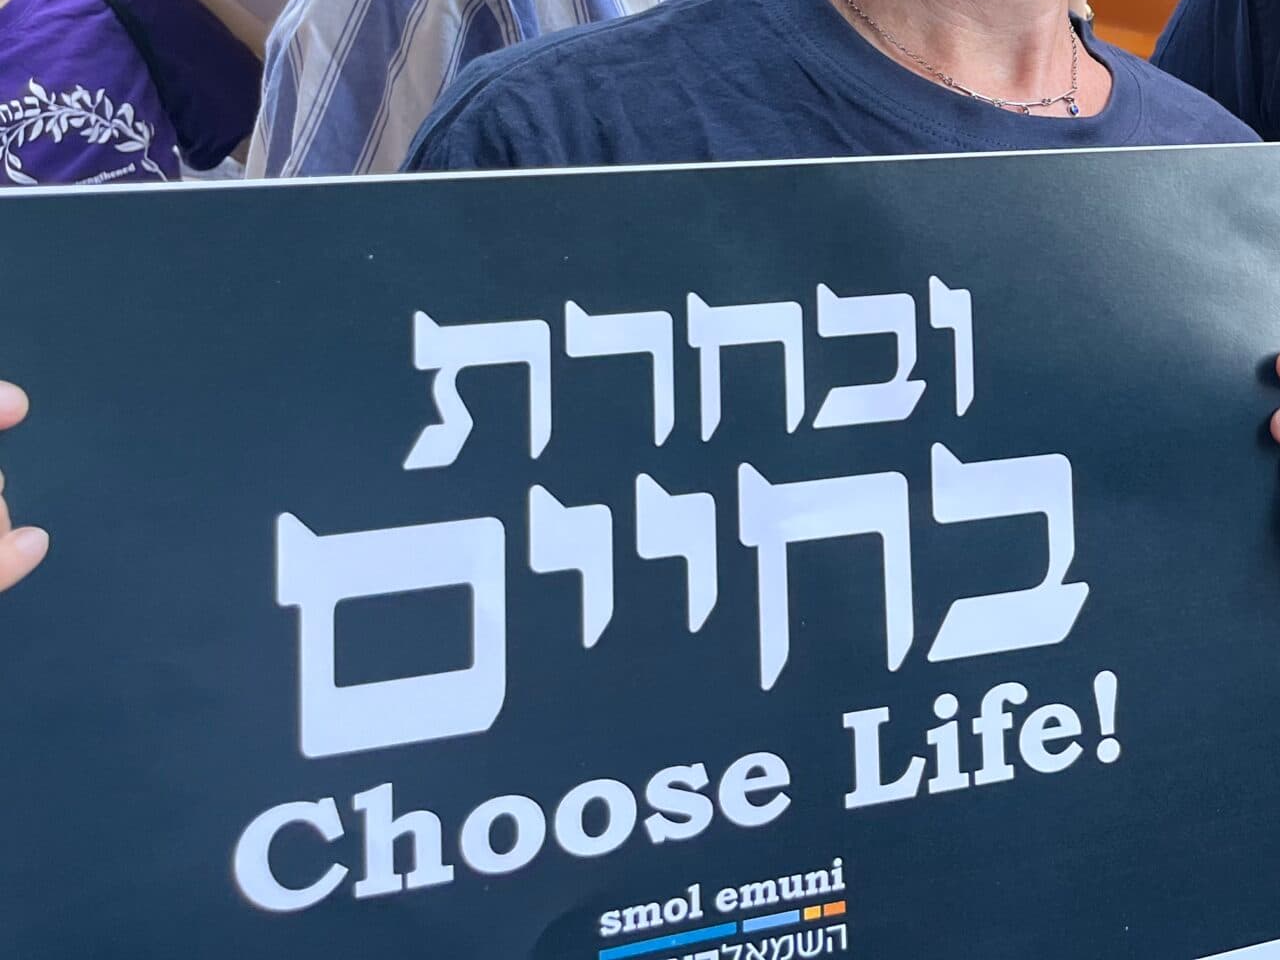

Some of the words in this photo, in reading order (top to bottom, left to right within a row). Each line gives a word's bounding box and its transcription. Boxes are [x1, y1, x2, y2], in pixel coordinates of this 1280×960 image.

[402, 275, 975, 471] ובחרת
[275, 442, 1090, 759] בחיים
[233, 751, 792, 912] Choose
[842, 670, 1121, 809] Life!
[599, 883, 704, 936] smol
[714, 857, 846, 913] emuni
